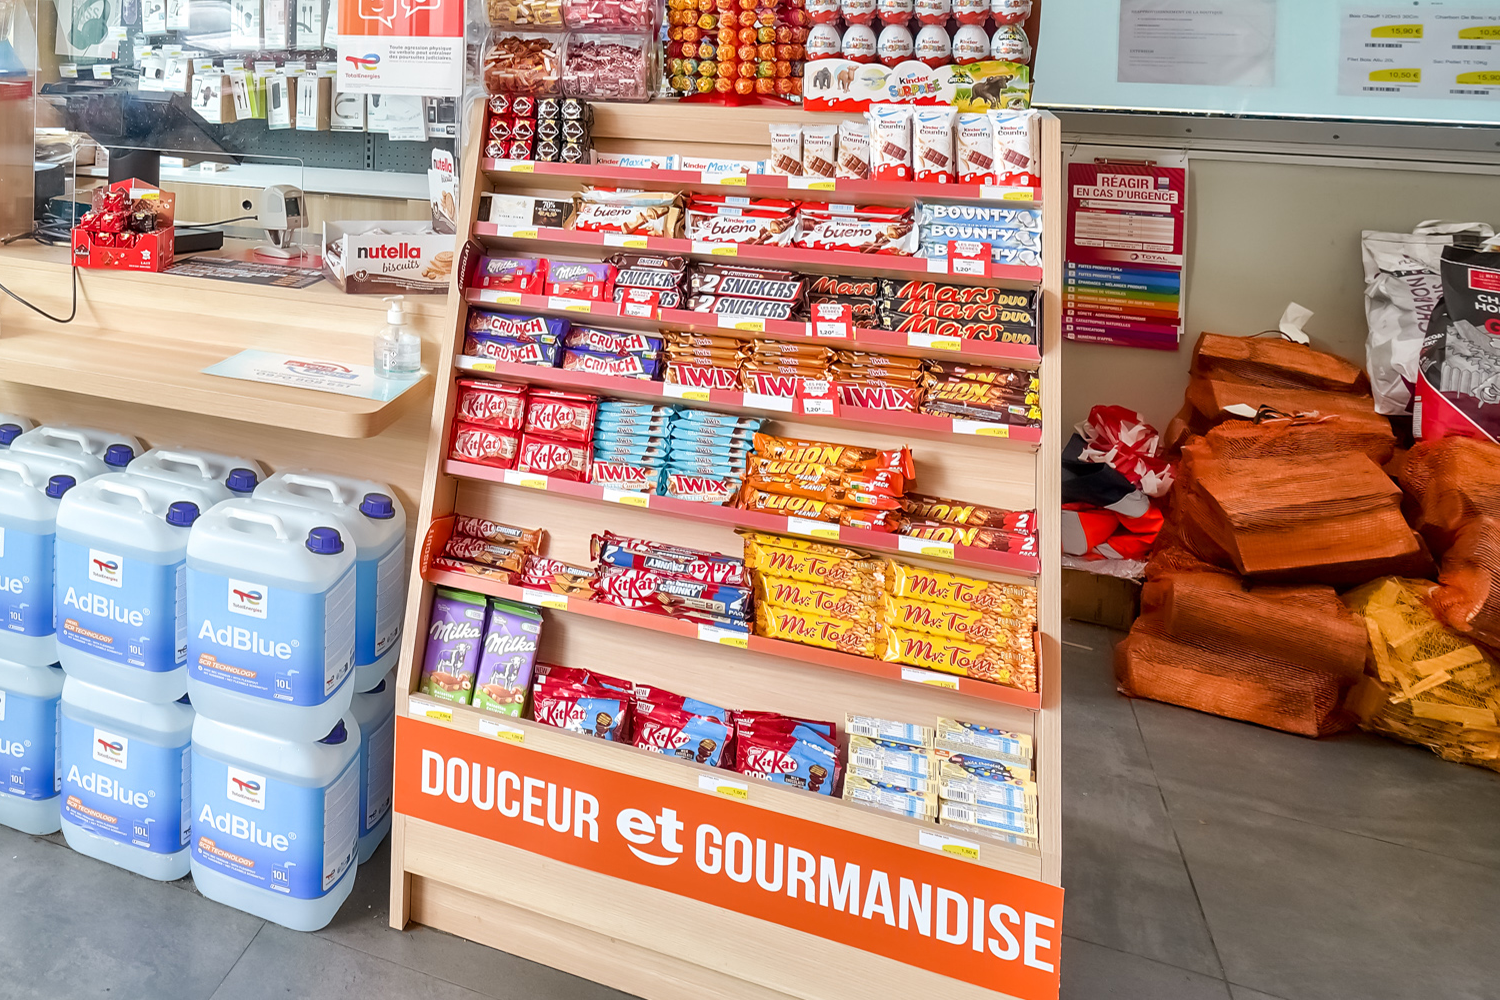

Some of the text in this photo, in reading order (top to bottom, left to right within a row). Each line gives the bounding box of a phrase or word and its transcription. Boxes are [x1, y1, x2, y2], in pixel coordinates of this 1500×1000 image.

[889, 79, 942, 98] SURPRISE
[899, 75, 929, 85] Kinder
[878, 121, 906, 132] Country
[919, 129, 949, 138] Country
[433, 158, 452, 173] nutella
[684, 161, 732, 173] Kinder Maxi
[1101, 174, 1149, 190] RÉAGIR
[1076, 187, 1175, 202] EN CAS D'URGENCE
[933, 205, 1017, 224] BOUNTY
[711, 223, 757, 235] bueno
[823, 224, 872, 239] bueno
[357, 242, 421, 259] nutella
[382, 260, 420, 273] biscuits
[458, 242, 471, 290] CHOCOLAT
[556, 264, 589, 280] Milka
[719, 277, 801, 299] SNICKERS
[812, 276, 878, 297] Mars
[899, 280, 1027, 307] Mars DUO
[491, 318, 543, 337] CRUNCH
[667, 361, 742, 390] TWIX
[461, 392, 503, 419] KitKat
[785, 445, 844, 466] LION
[593, 460, 646, 483] TWIX
[767, 493, 825, 513] LION
[794, 508, 821, 519] PEANUT
[421, 528, 435, 575] BISCUIT
[807, 555, 850, 580] Tom
[603, 570, 700, 597] KitKat CHUNKY
[429, 620, 482, 642] Milka
[199, 659, 211, 668] SCR
[212, 661, 257, 679] TECHNOLOGY
[944, 645, 995, 675] Tom
[643, 724, 691, 749] KitKat
[421, 748, 1056, 974] DOUCEUR et GOURMANDISE
